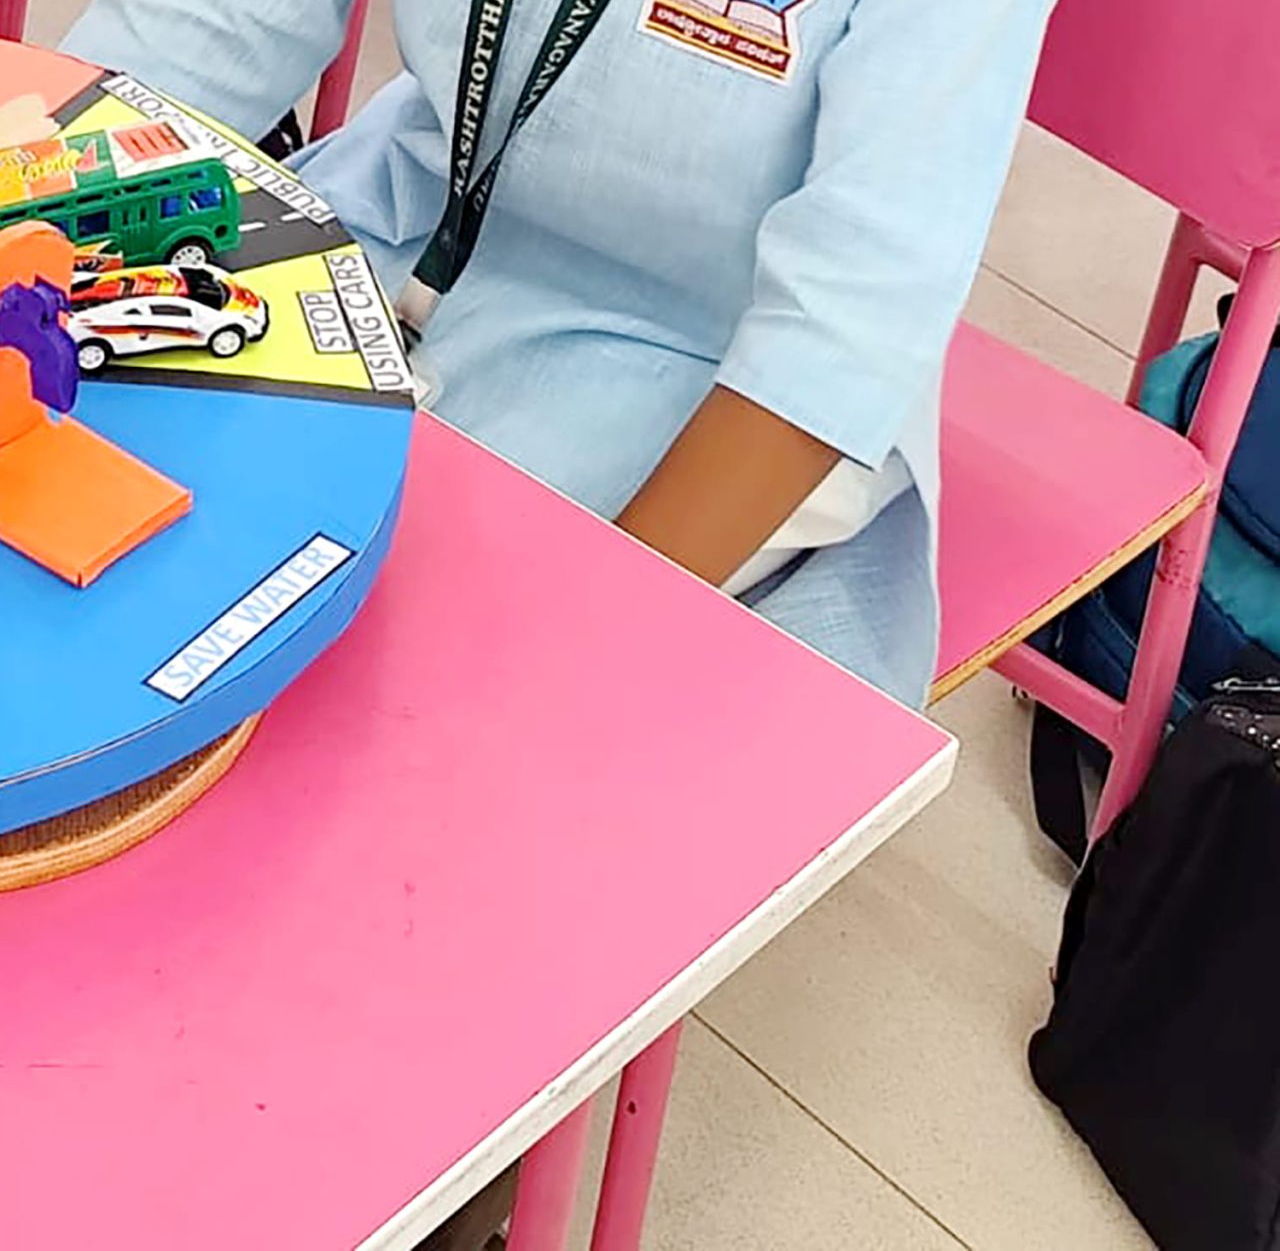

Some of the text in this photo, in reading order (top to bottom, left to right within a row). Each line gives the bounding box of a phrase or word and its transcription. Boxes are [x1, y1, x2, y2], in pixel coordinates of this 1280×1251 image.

[235, 161, 331, 222] PUBLIC
[304, 294, 347, 348] STOP
[330, 254, 405, 387] USING CARS
[163, 546, 335, 688] SAVE WATER
